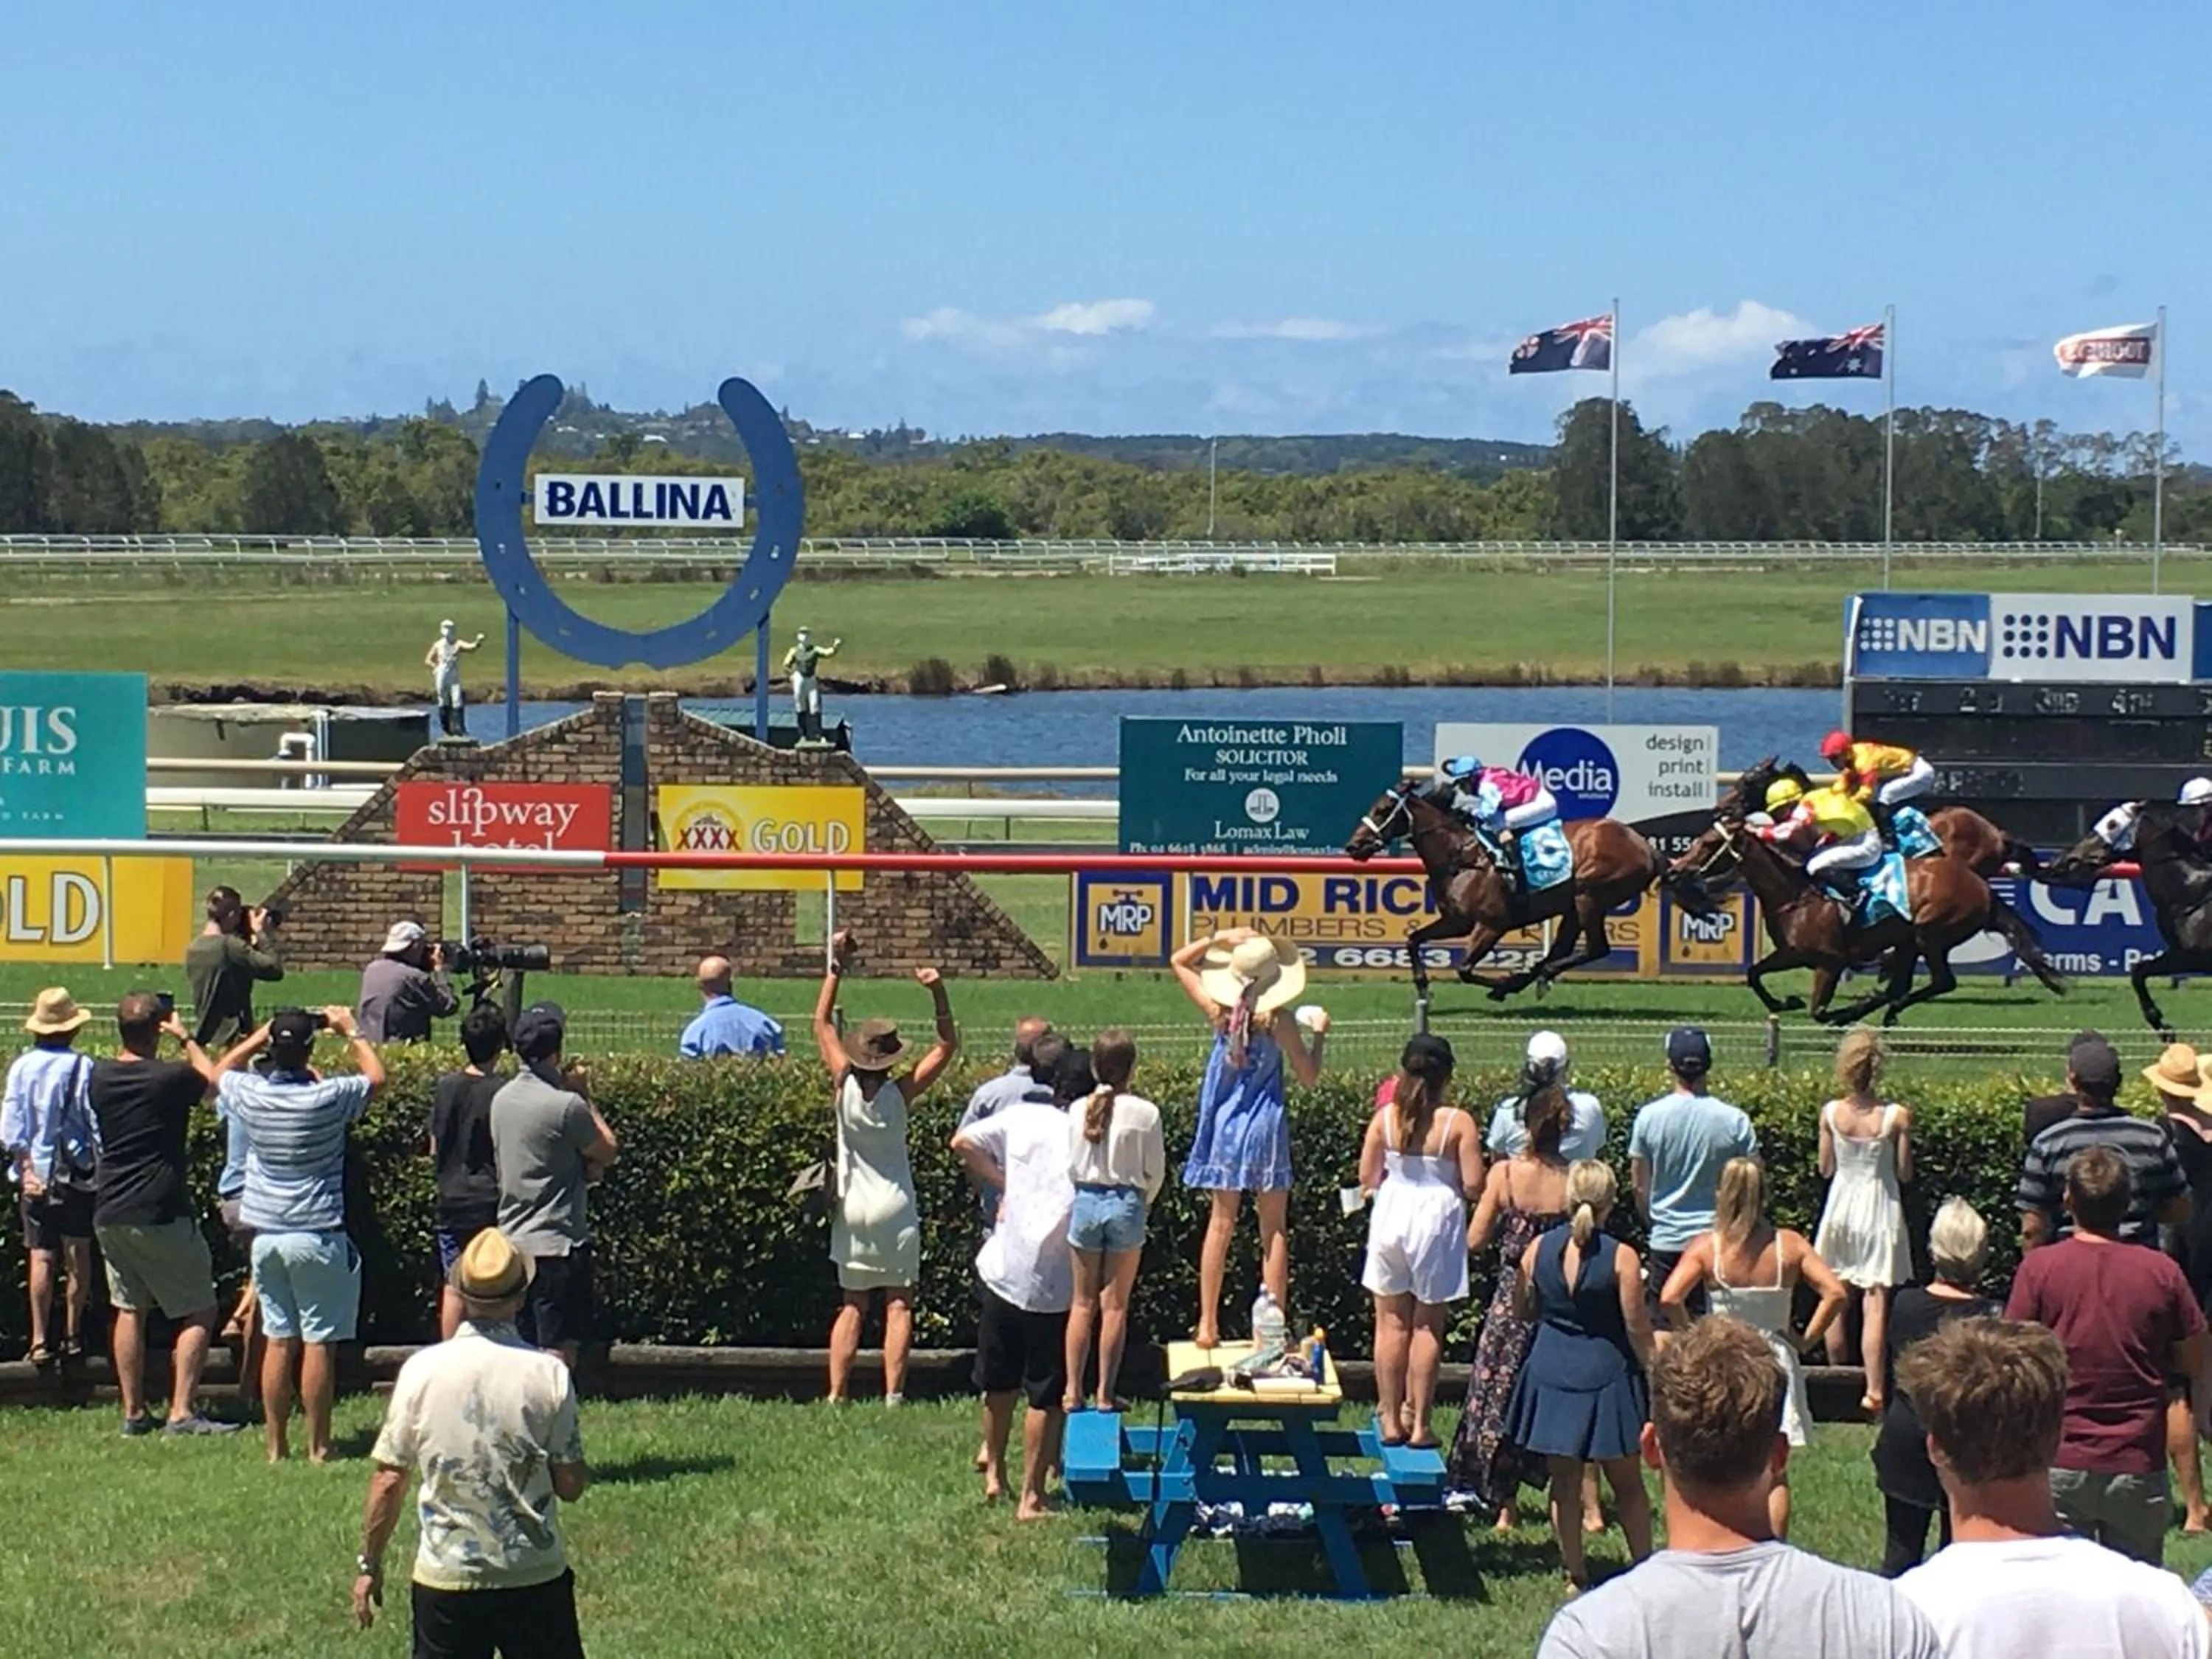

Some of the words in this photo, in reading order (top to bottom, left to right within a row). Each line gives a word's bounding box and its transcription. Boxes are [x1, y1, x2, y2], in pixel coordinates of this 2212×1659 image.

[547, 481, 732, 521] BALLINA
[1897, 619, 1987, 653] NBN
[2054, 614, 2177, 660] NBN
[1177, 723, 1288, 745] Antoinette
[1293, 725, 1348, 745] Pholl
[1646, 734, 1704, 754] design
[3, 757, 75, 775] FARM
[1215, 748, 1309, 766] SOLICITOR
[1658, 758, 1703, 777] print
[1185, 768, 1206, 782] For
[1209, 768, 1226, 782] all
[1228, 771, 1260, 785] your
[1263, 769, 1294, 785] legal
[1298, 770, 1338, 783] needs
[1520, 759, 1613, 792] Media
[1648, 780, 1703, 798] install
[428, 787, 580, 838] slipway
[675, 827, 742, 850] XXXX
[752, 818, 852, 855] GOLD
[0, 872, 102, 945] LD
[1192, 875, 1300, 914] MID
[1099, 904, 1152, 933] MRP
